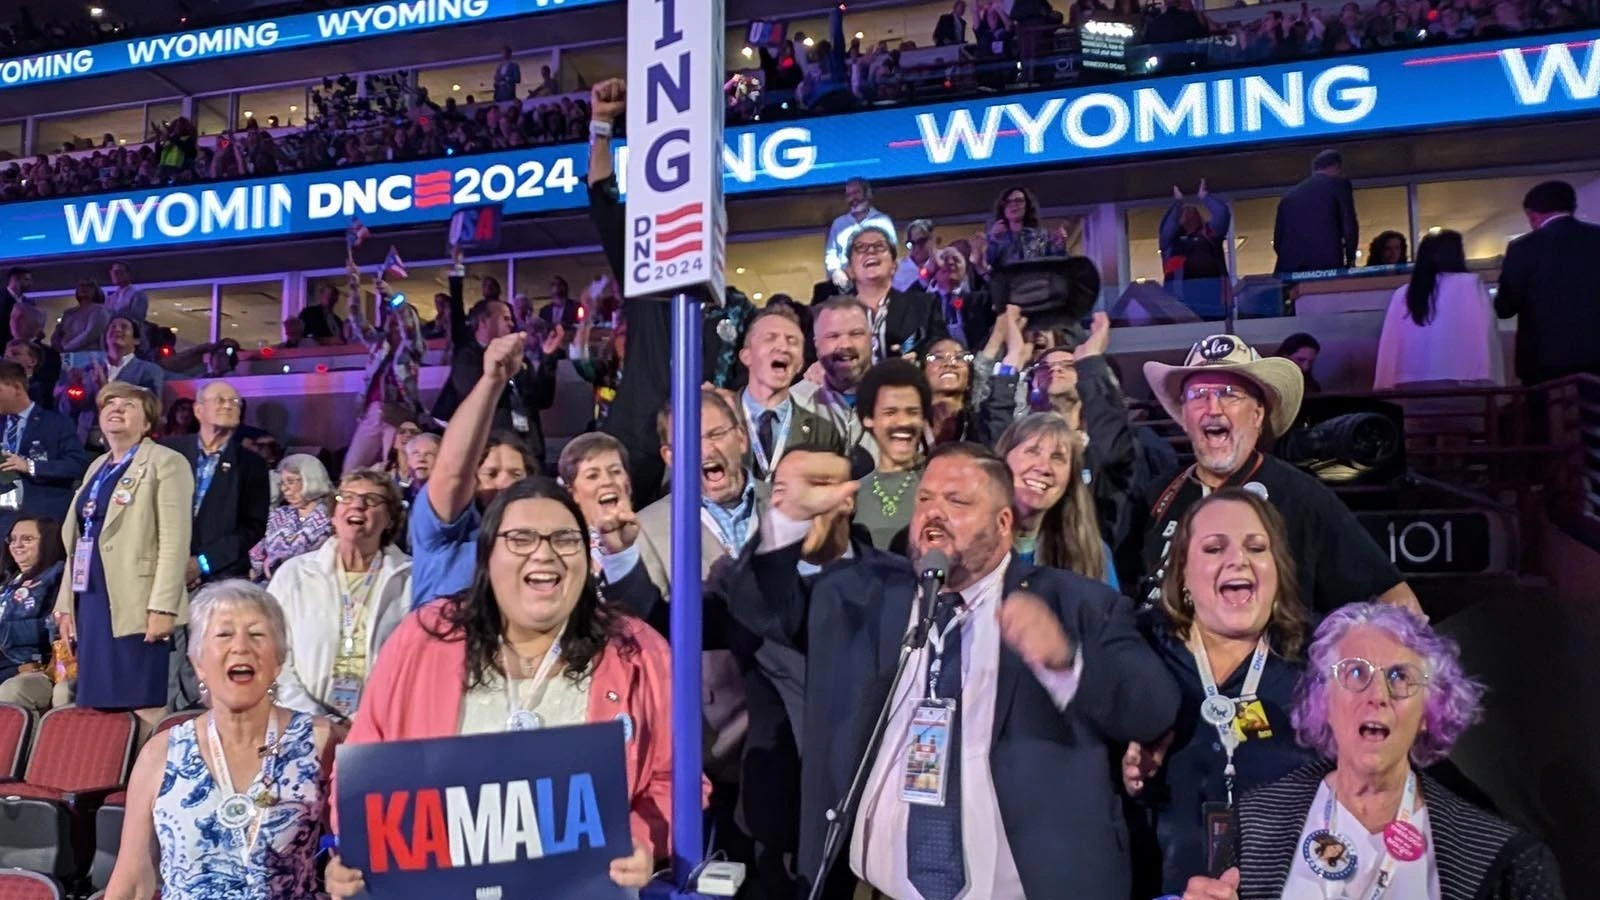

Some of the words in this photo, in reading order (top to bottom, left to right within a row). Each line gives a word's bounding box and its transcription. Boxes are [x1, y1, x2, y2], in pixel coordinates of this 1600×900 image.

[127, 22, 279, 65] WYOMING
[318, 0, 489, 38] WYOMING
[915, 64, 1378, 165] WYOMING
[308, 175, 412, 220] DNC
[453, 157, 579, 204] 2024
[633, 216, 652, 284] DNC
[654, 256, 703, 281] 2024
[1387, 520, 1453, 563] 101
[364, 773, 606, 873] KAMALA
